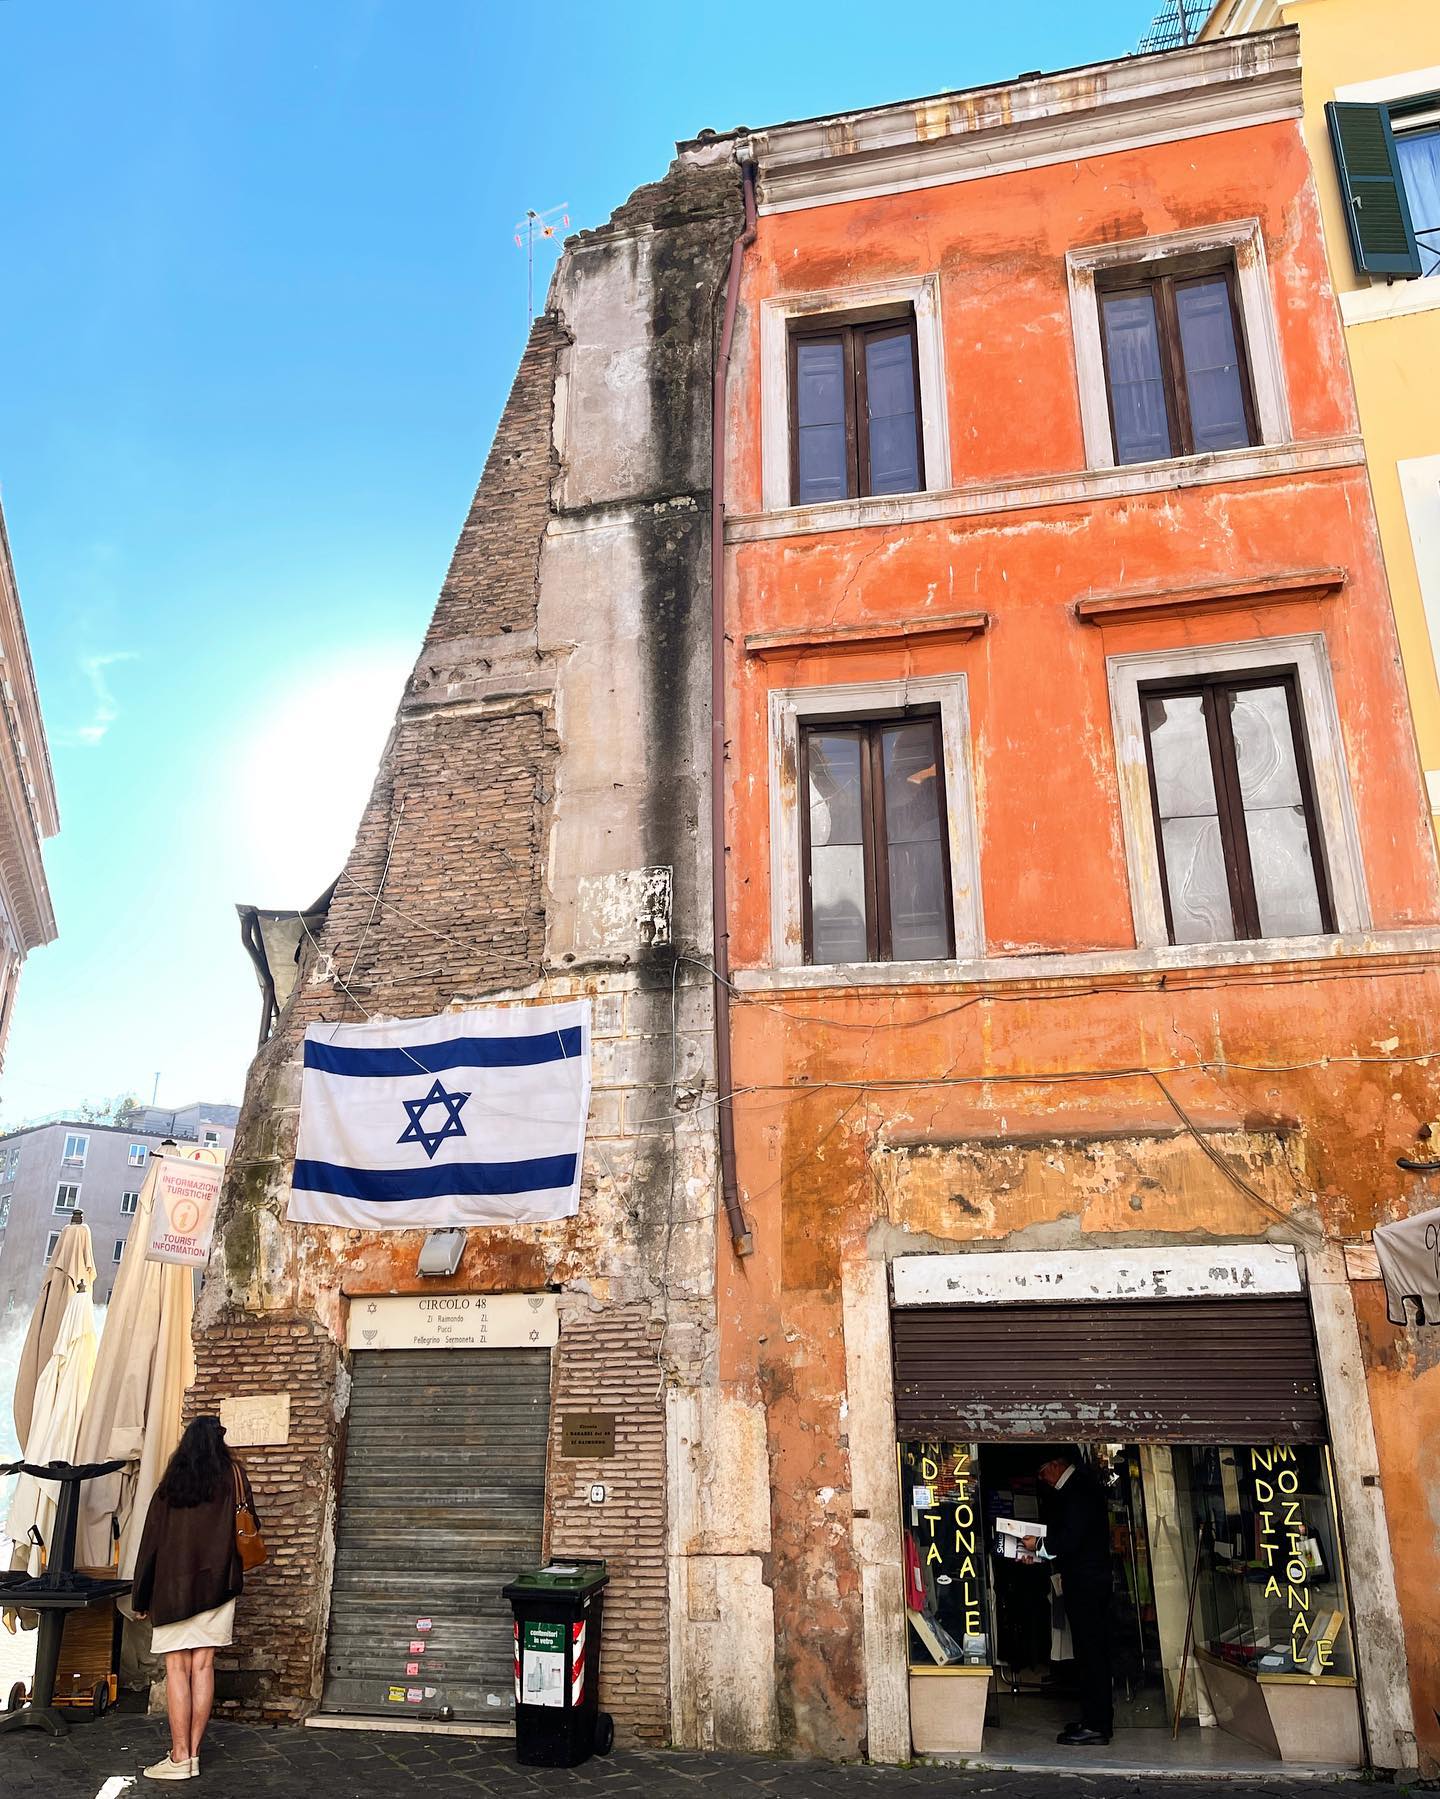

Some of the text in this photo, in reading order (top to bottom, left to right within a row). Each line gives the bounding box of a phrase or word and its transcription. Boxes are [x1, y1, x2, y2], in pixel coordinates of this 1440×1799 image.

[162, 1175, 219, 1194] INFORMAZIONI
[167, 1185, 213, 1201] TURISTICHE
[163, 1233, 197, 1246] TOURIST
[152, 1241, 206, 1257] INFORMATION
[418, 1298, 487, 1311] CIRCOLO 48
[437, 1314, 464, 1323] Raimondo
[437, 1325, 452, 1334] Pucci
[413, 1336, 441, 1345] Pellegrino
[445, 1335, 475, 1344] Sermoneta
[952, 1443, 981, 1637] ZIONALE
